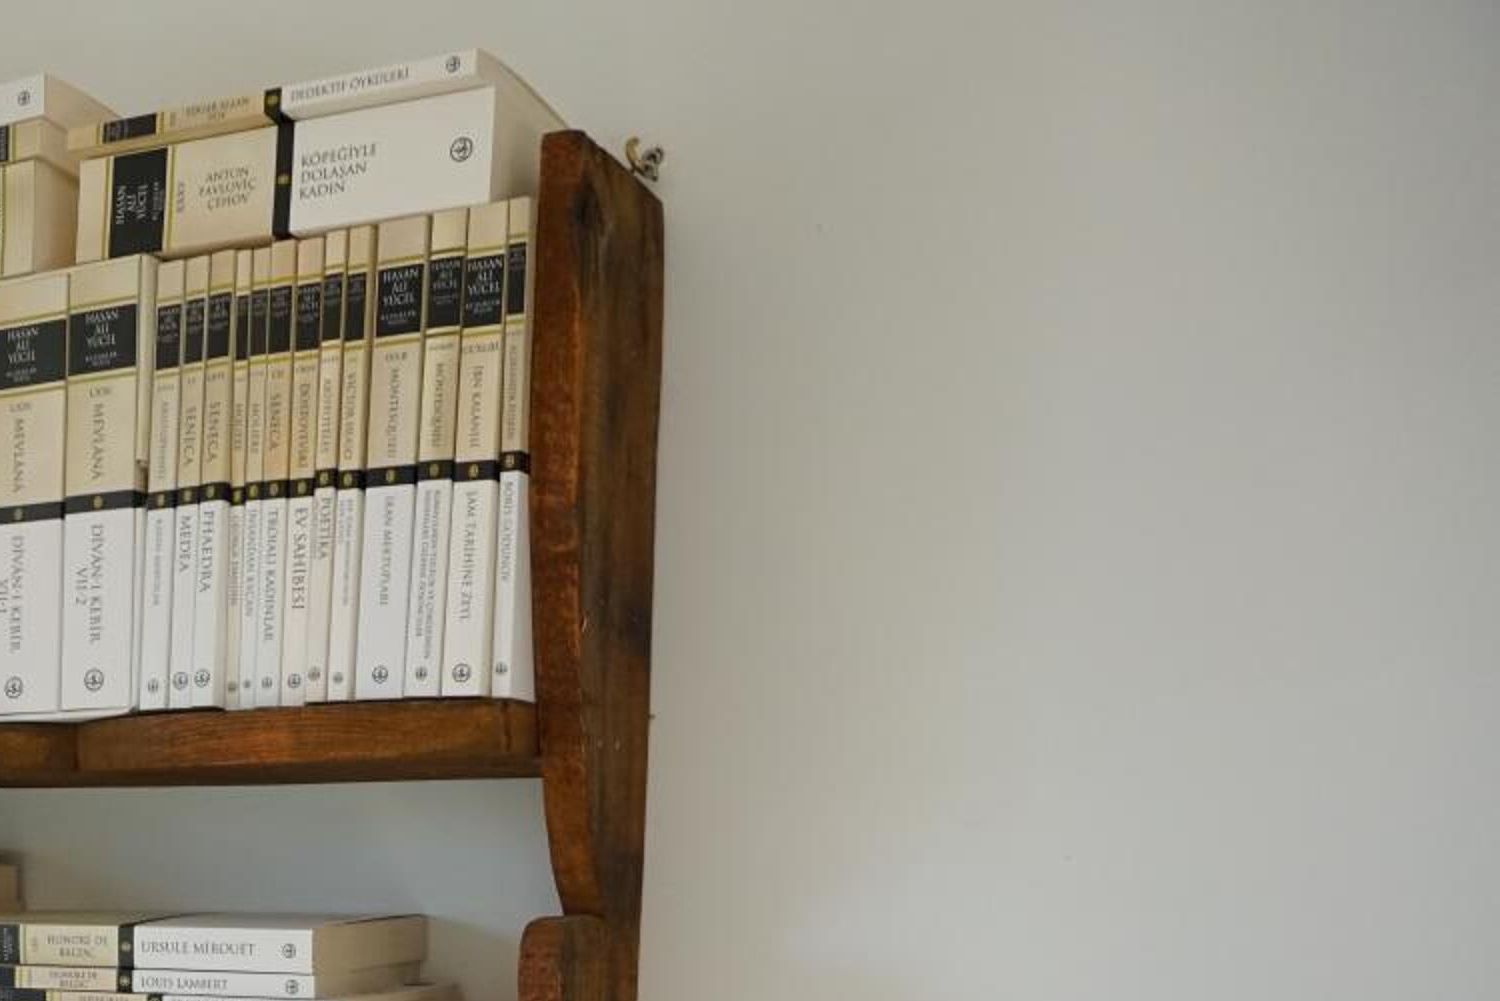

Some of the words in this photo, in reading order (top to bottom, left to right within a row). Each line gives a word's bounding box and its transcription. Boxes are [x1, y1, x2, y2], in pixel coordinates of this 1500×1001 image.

[300, 181, 346, 199] KADIN
[301, 162, 369, 184] DOLAŞAN
[183, 405, 197, 466] SENECA
[206, 401, 221, 464] SENECA
[268, 392, 281, 451] SENECA
[294, 506, 308, 527] EV
[178, 515, 192, 573] MEDEA
[199, 509, 215, 593] PHAEDRA
[141, 940, 188, 955] URSULE
[140, 976, 173, 990] LOUIS
[176, 977, 229, 991] LAMBERT
